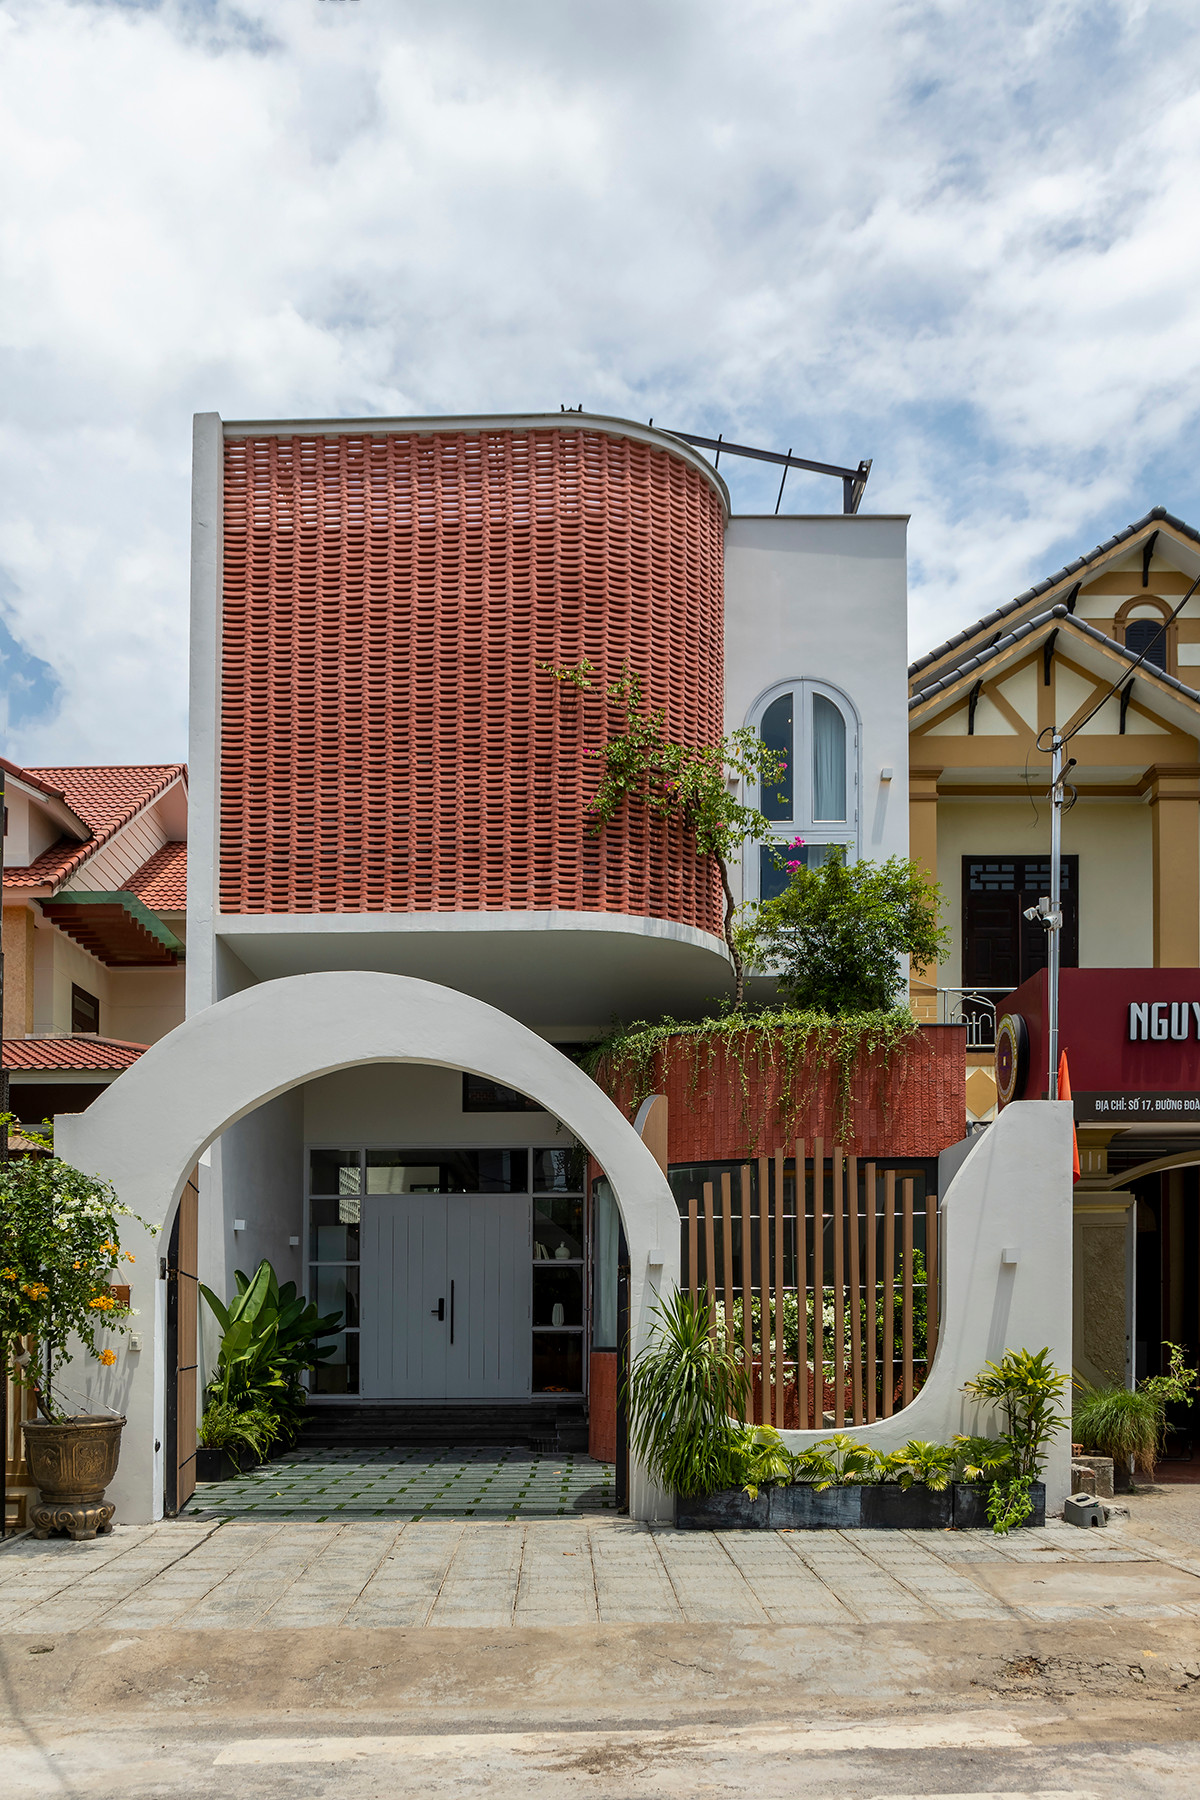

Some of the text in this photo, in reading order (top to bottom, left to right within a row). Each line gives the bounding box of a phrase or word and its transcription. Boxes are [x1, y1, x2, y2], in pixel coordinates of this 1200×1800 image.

[1095, 1097, 1200, 1112] ĐỊA CHỈ: SỐ 17, ĐƯỜNG ĐOÀ
